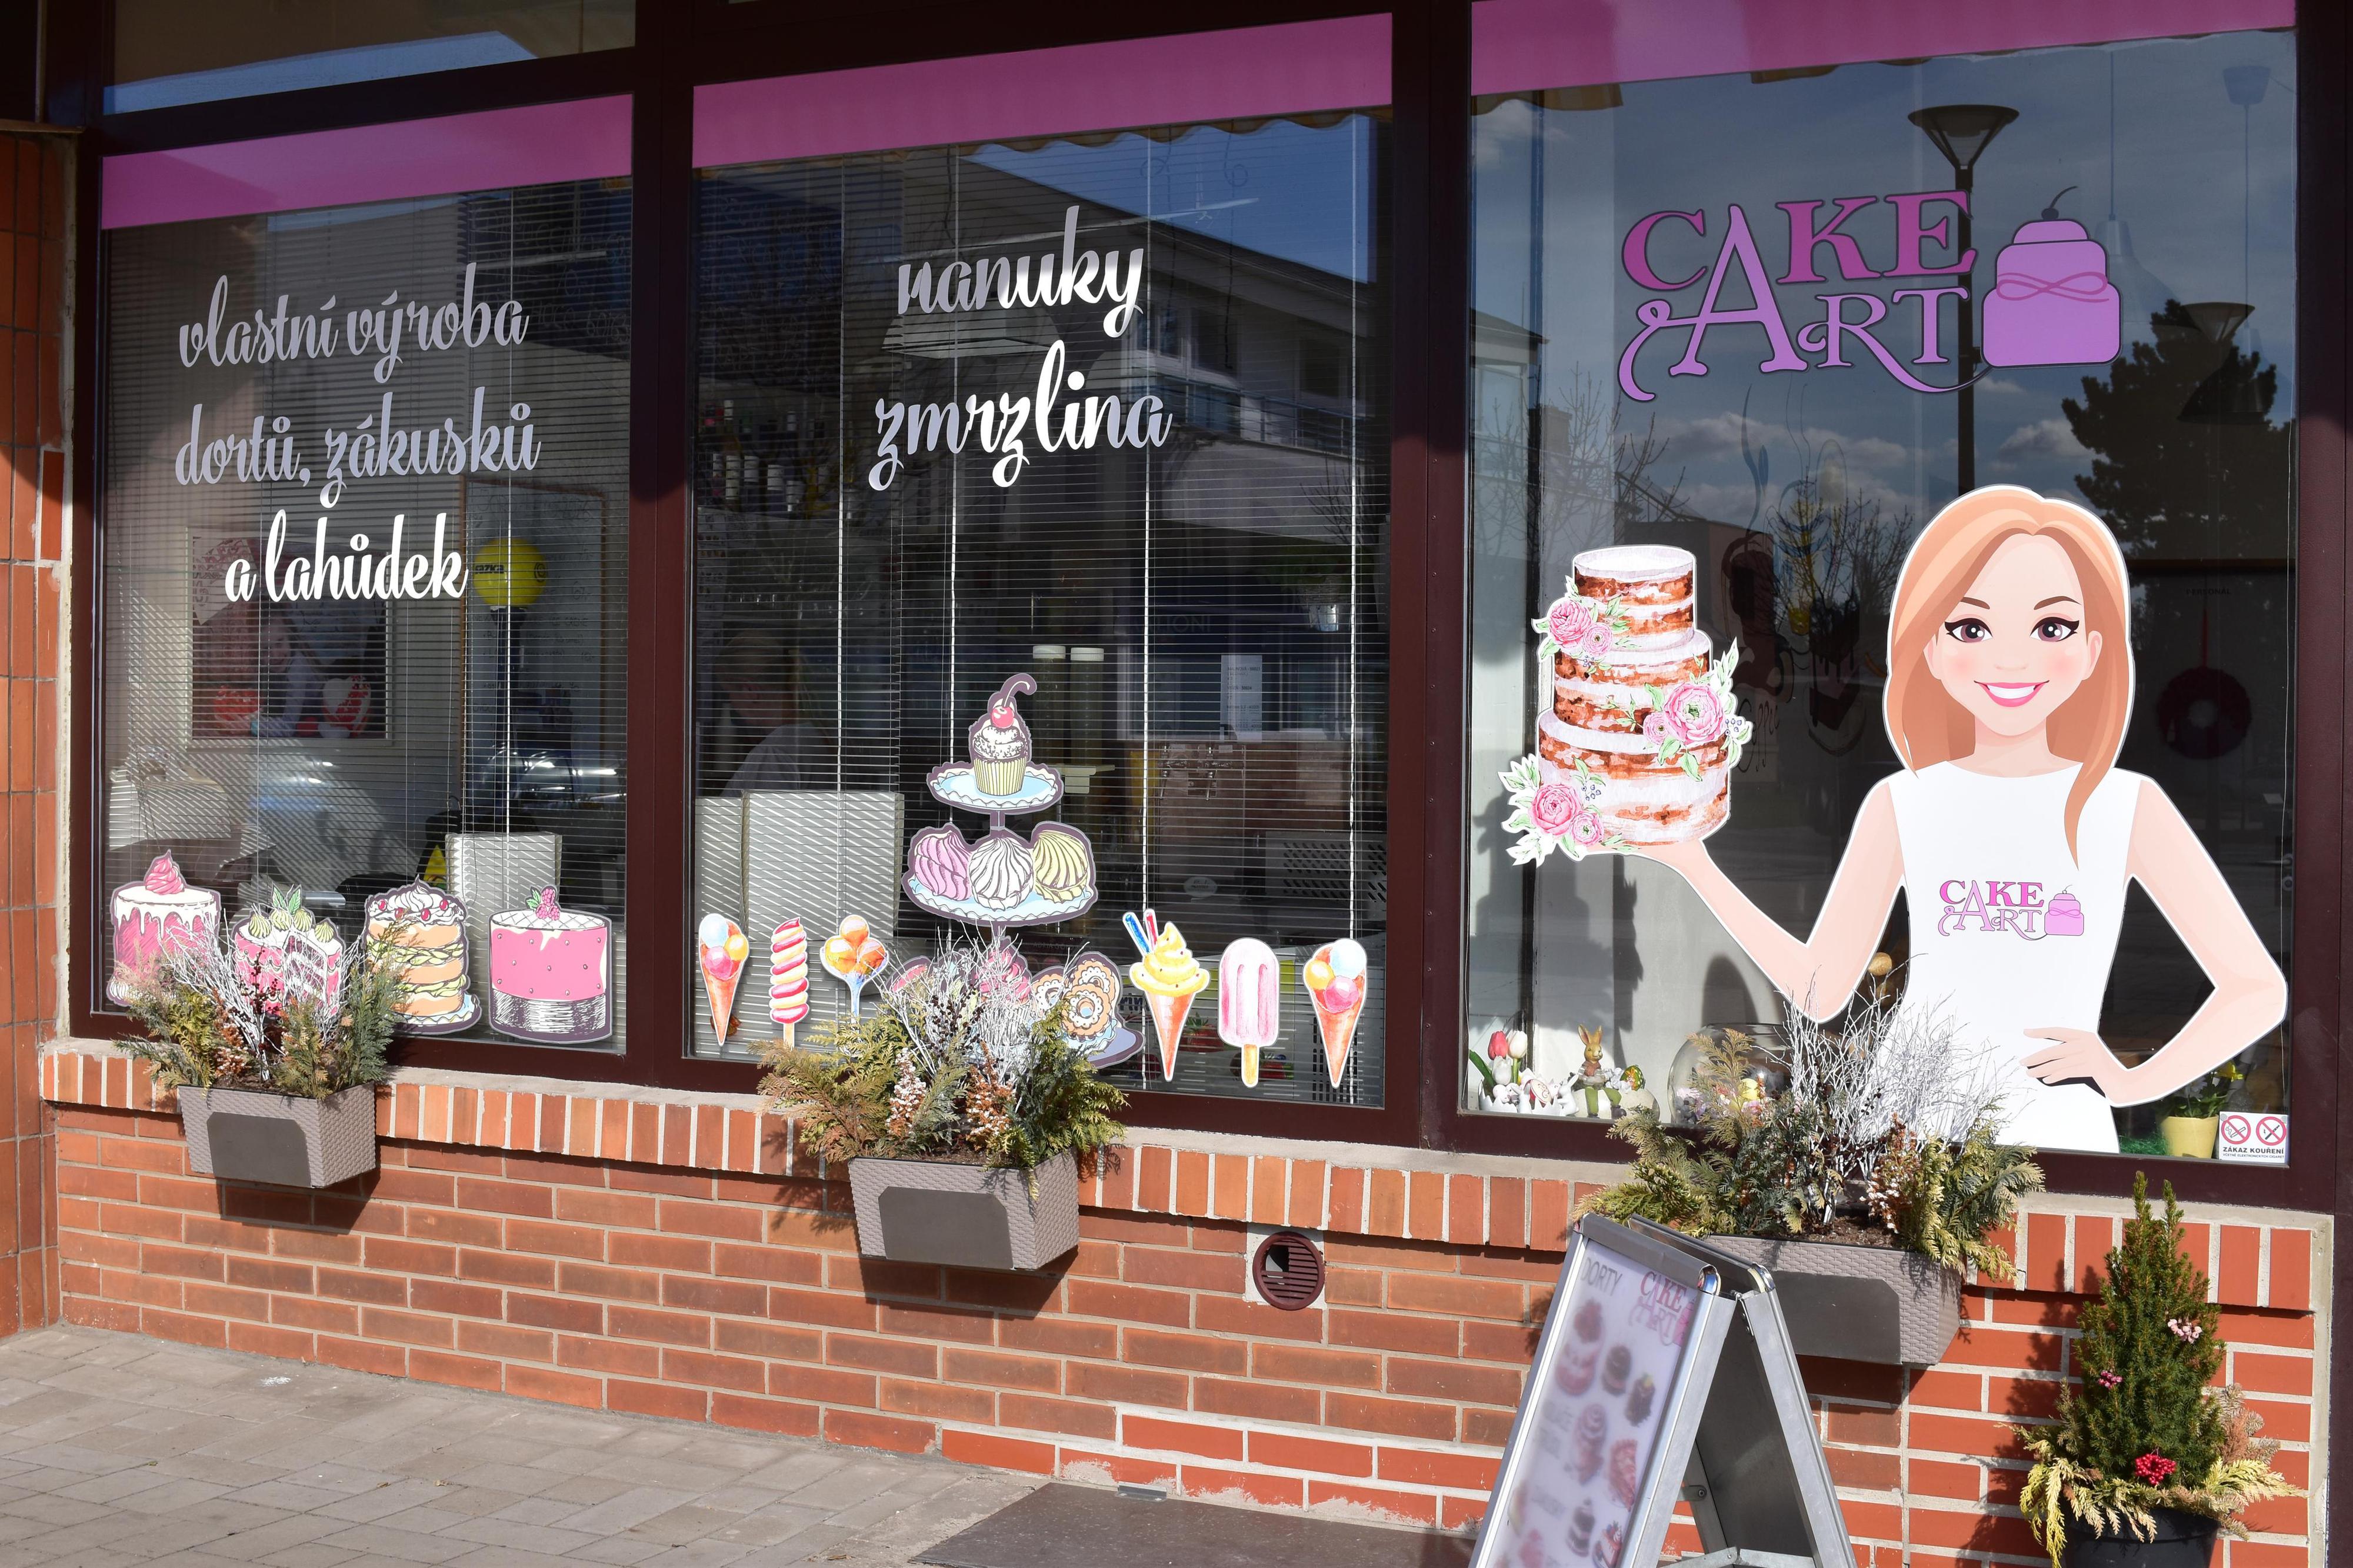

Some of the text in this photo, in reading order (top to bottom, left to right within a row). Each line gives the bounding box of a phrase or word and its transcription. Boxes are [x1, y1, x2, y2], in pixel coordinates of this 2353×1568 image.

[898, 205, 1144, 338] nanuky
[1622, 189, 1978, 291] CAKE
[179, 262, 529, 384] vlastní výroba
[1617, 203, 1993, 402] ART
[175, 386, 542, 509] dortů, zákusků
[868, 339, 1174, 491] zmrzlina
[224, 558, 256, 602] a
[264, 508, 469, 603] lahůdek
[1938, 880, 2048, 940] ART
[1939, 880, 2045, 908] CAKE
[1581, 1257, 1624, 1297] DORTY
[1640, 1270, 1688, 1313] CAKE
